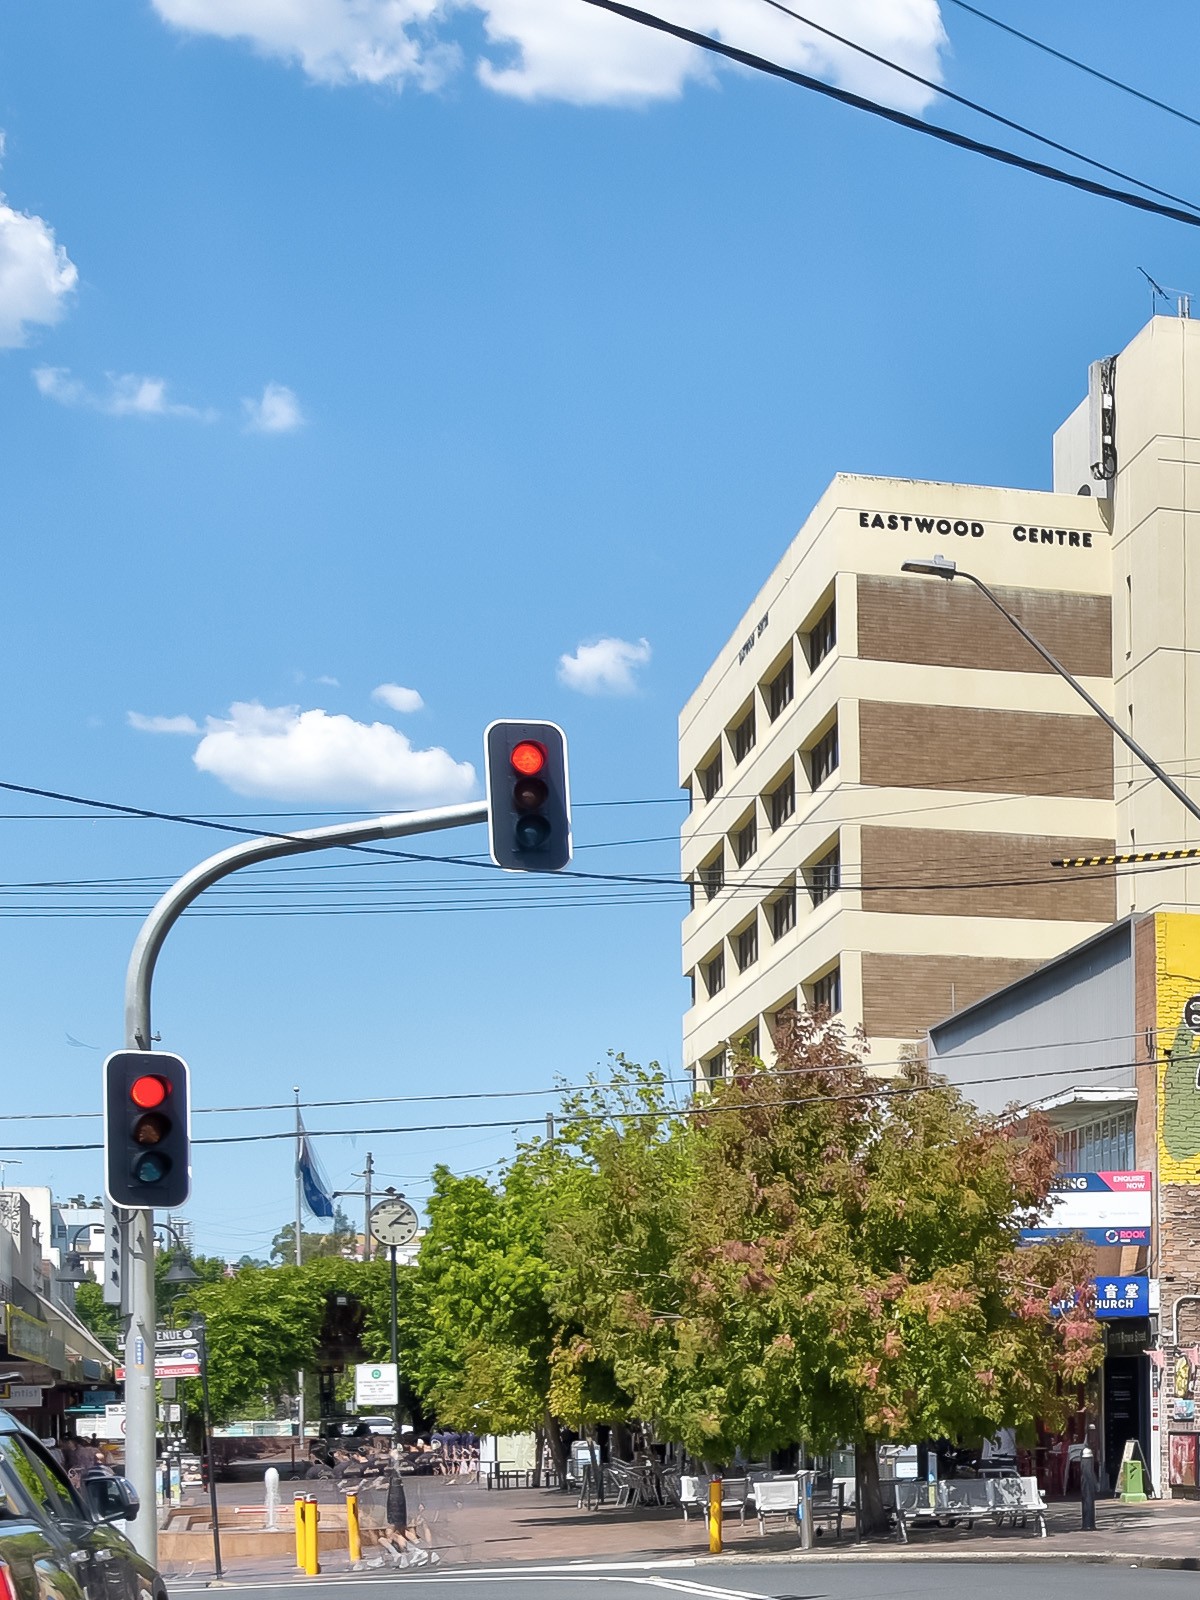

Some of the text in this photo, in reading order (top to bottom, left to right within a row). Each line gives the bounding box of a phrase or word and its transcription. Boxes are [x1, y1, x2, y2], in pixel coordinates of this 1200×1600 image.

[859, 512, 1093, 548] EASTWOOD CENTRE
[1113, 1175, 1146, 1183] ENQUIRE
[1126, 1182, 1146, 1190] NOW
[1119, 1230, 1146, 1239] ROOK
[1087, 1300, 1134, 1309] HURCH
[156, 1330, 183, 1340] ENUE
